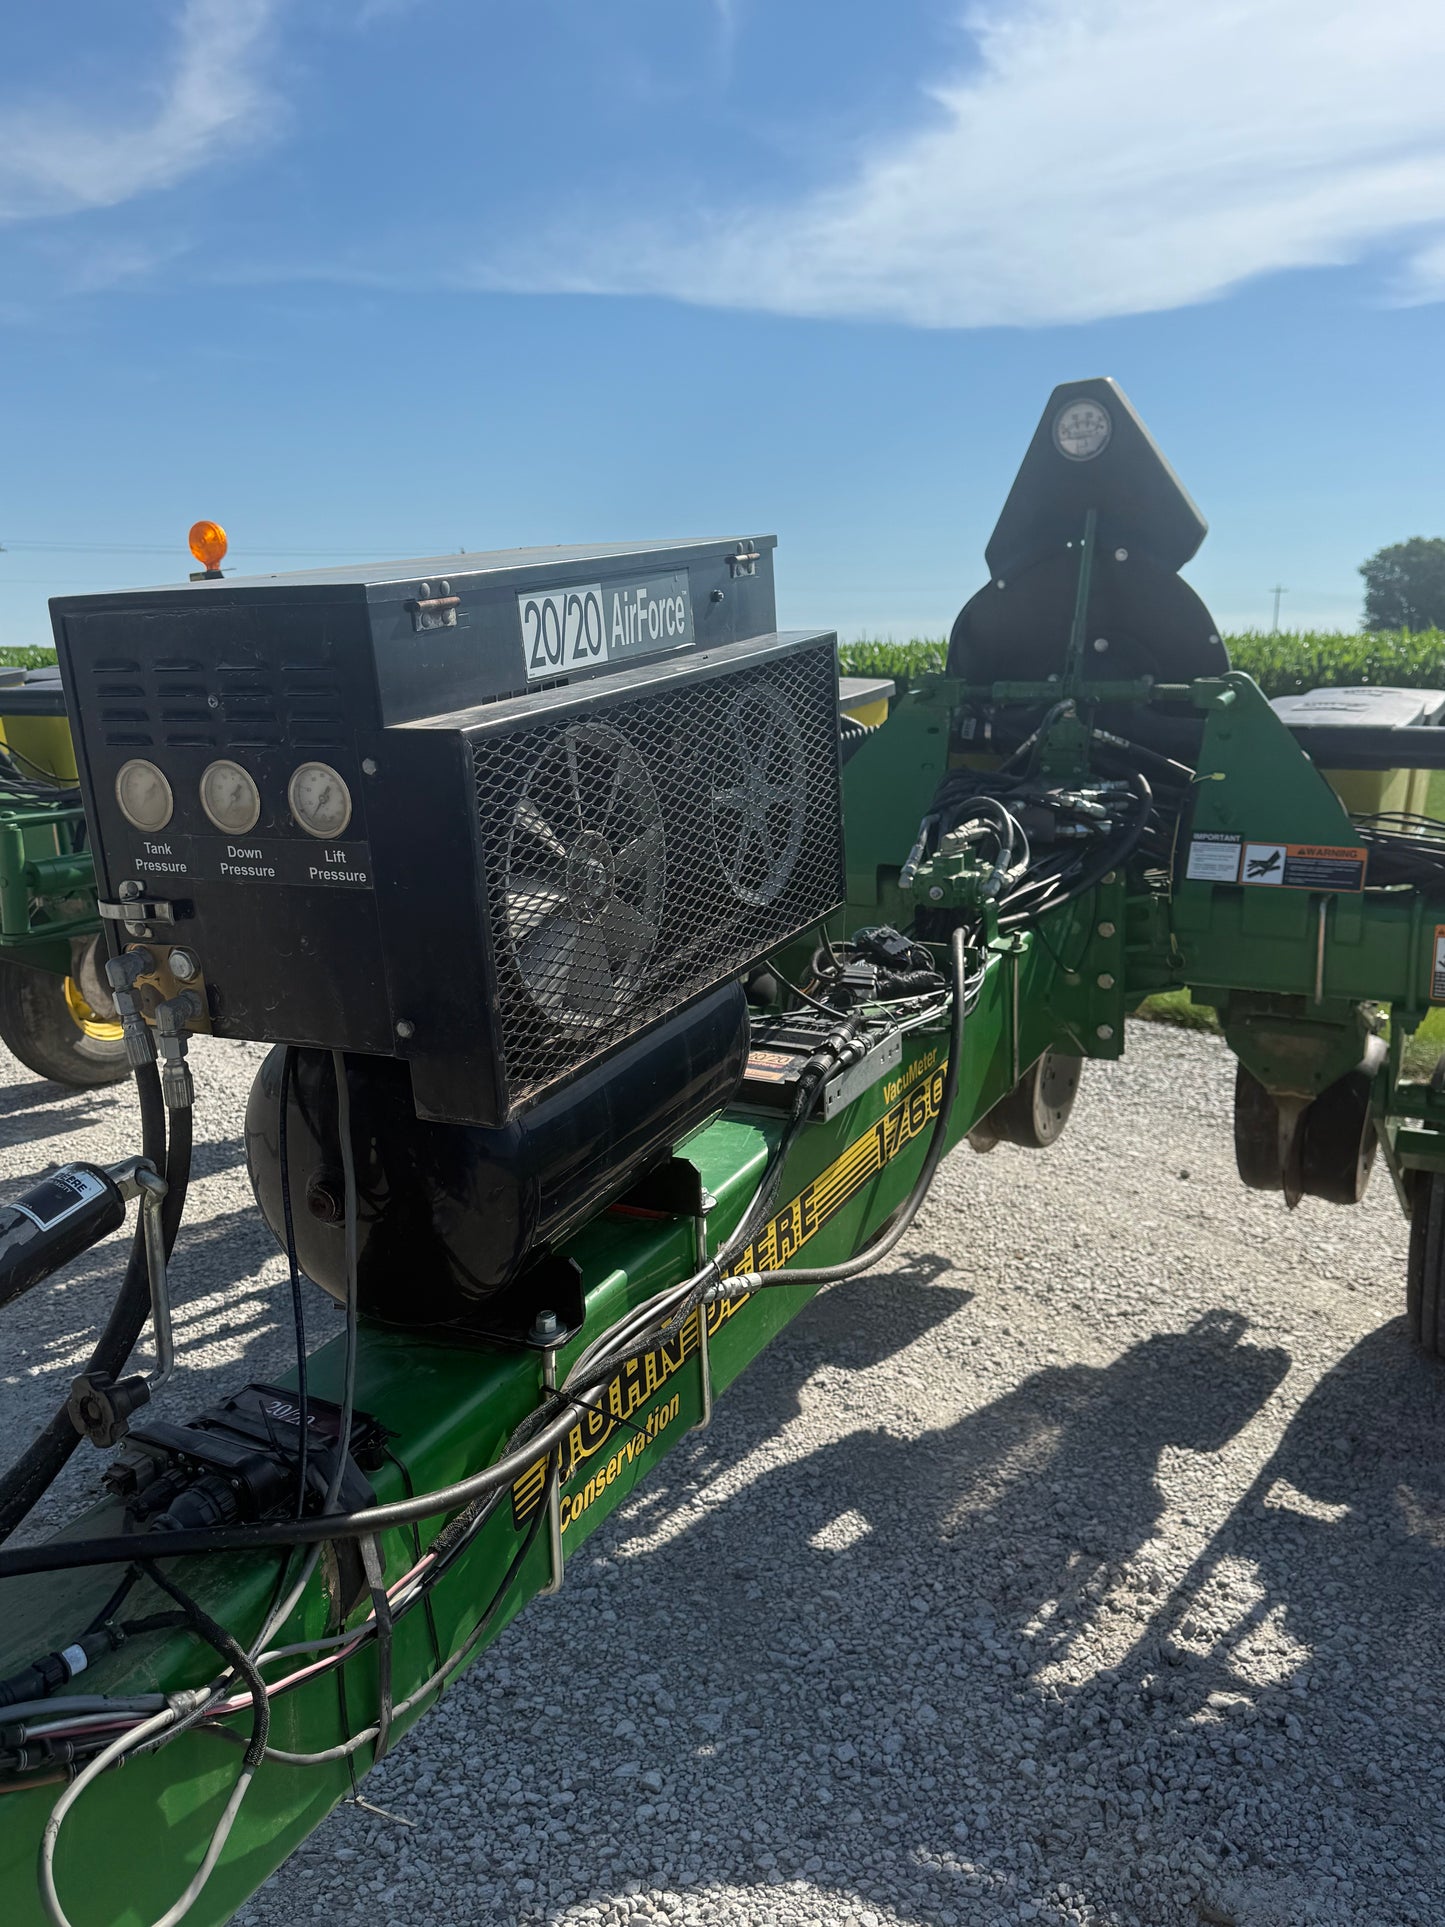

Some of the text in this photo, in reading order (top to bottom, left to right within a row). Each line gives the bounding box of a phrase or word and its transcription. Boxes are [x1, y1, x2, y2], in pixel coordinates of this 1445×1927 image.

[524, 588, 685, 669] 20/20 AirForce
[1193, 832, 1241, 842] IMPORTANT
[143, 842, 172, 855] Tank
[227, 845, 263, 859] Down
[1306, 847, 1358, 858] WARNING
[324, 849, 347, 864] Lift
[135, 858, 187, 873] Pressure
[220, 862, 276, 878] Pressure
[309, 867, 367, 883] Pressure
[883, 1047, 937, 1105] VacuMeter
[559, 1391, 680, 1534] Conservation
